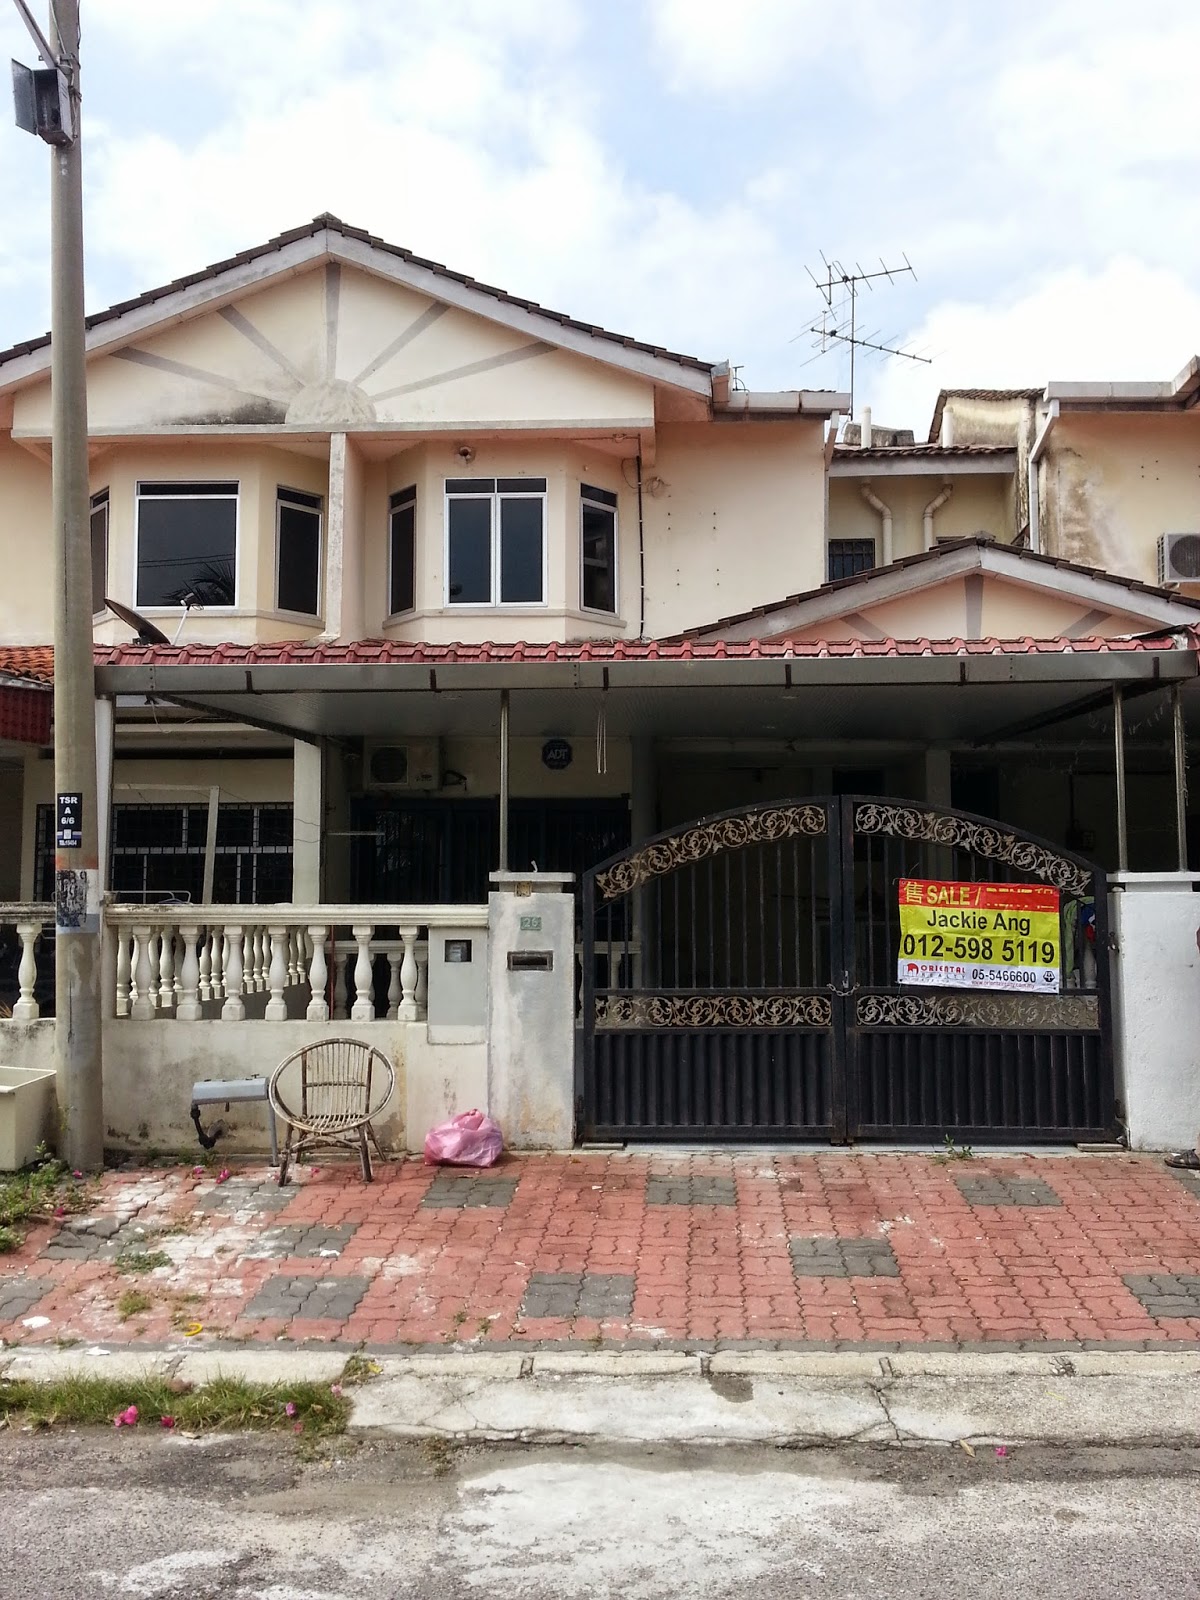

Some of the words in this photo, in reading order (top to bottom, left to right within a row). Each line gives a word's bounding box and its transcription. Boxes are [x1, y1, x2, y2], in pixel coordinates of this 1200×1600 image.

[546, 748, 568, 760] ADT
[59, 796, 78, 804] TSR
[64, 806, 72, 814] A
[61, 816, 75, 825] 6/6
[904, 881, 924, 904] 售
[926, 885, 971, 906] SALE
[523, 917, 538, 927] 26
[927, 909, 988, 930] Jackie
[992, 912, 1031, 936] Ang
[903, 934, 993, 961] 012-598
[1001, 939, 1055, 964] 5119
[920, 964, 966, 974] ORIENTAL
[972, 968, 1037, 983] 05-5466600
